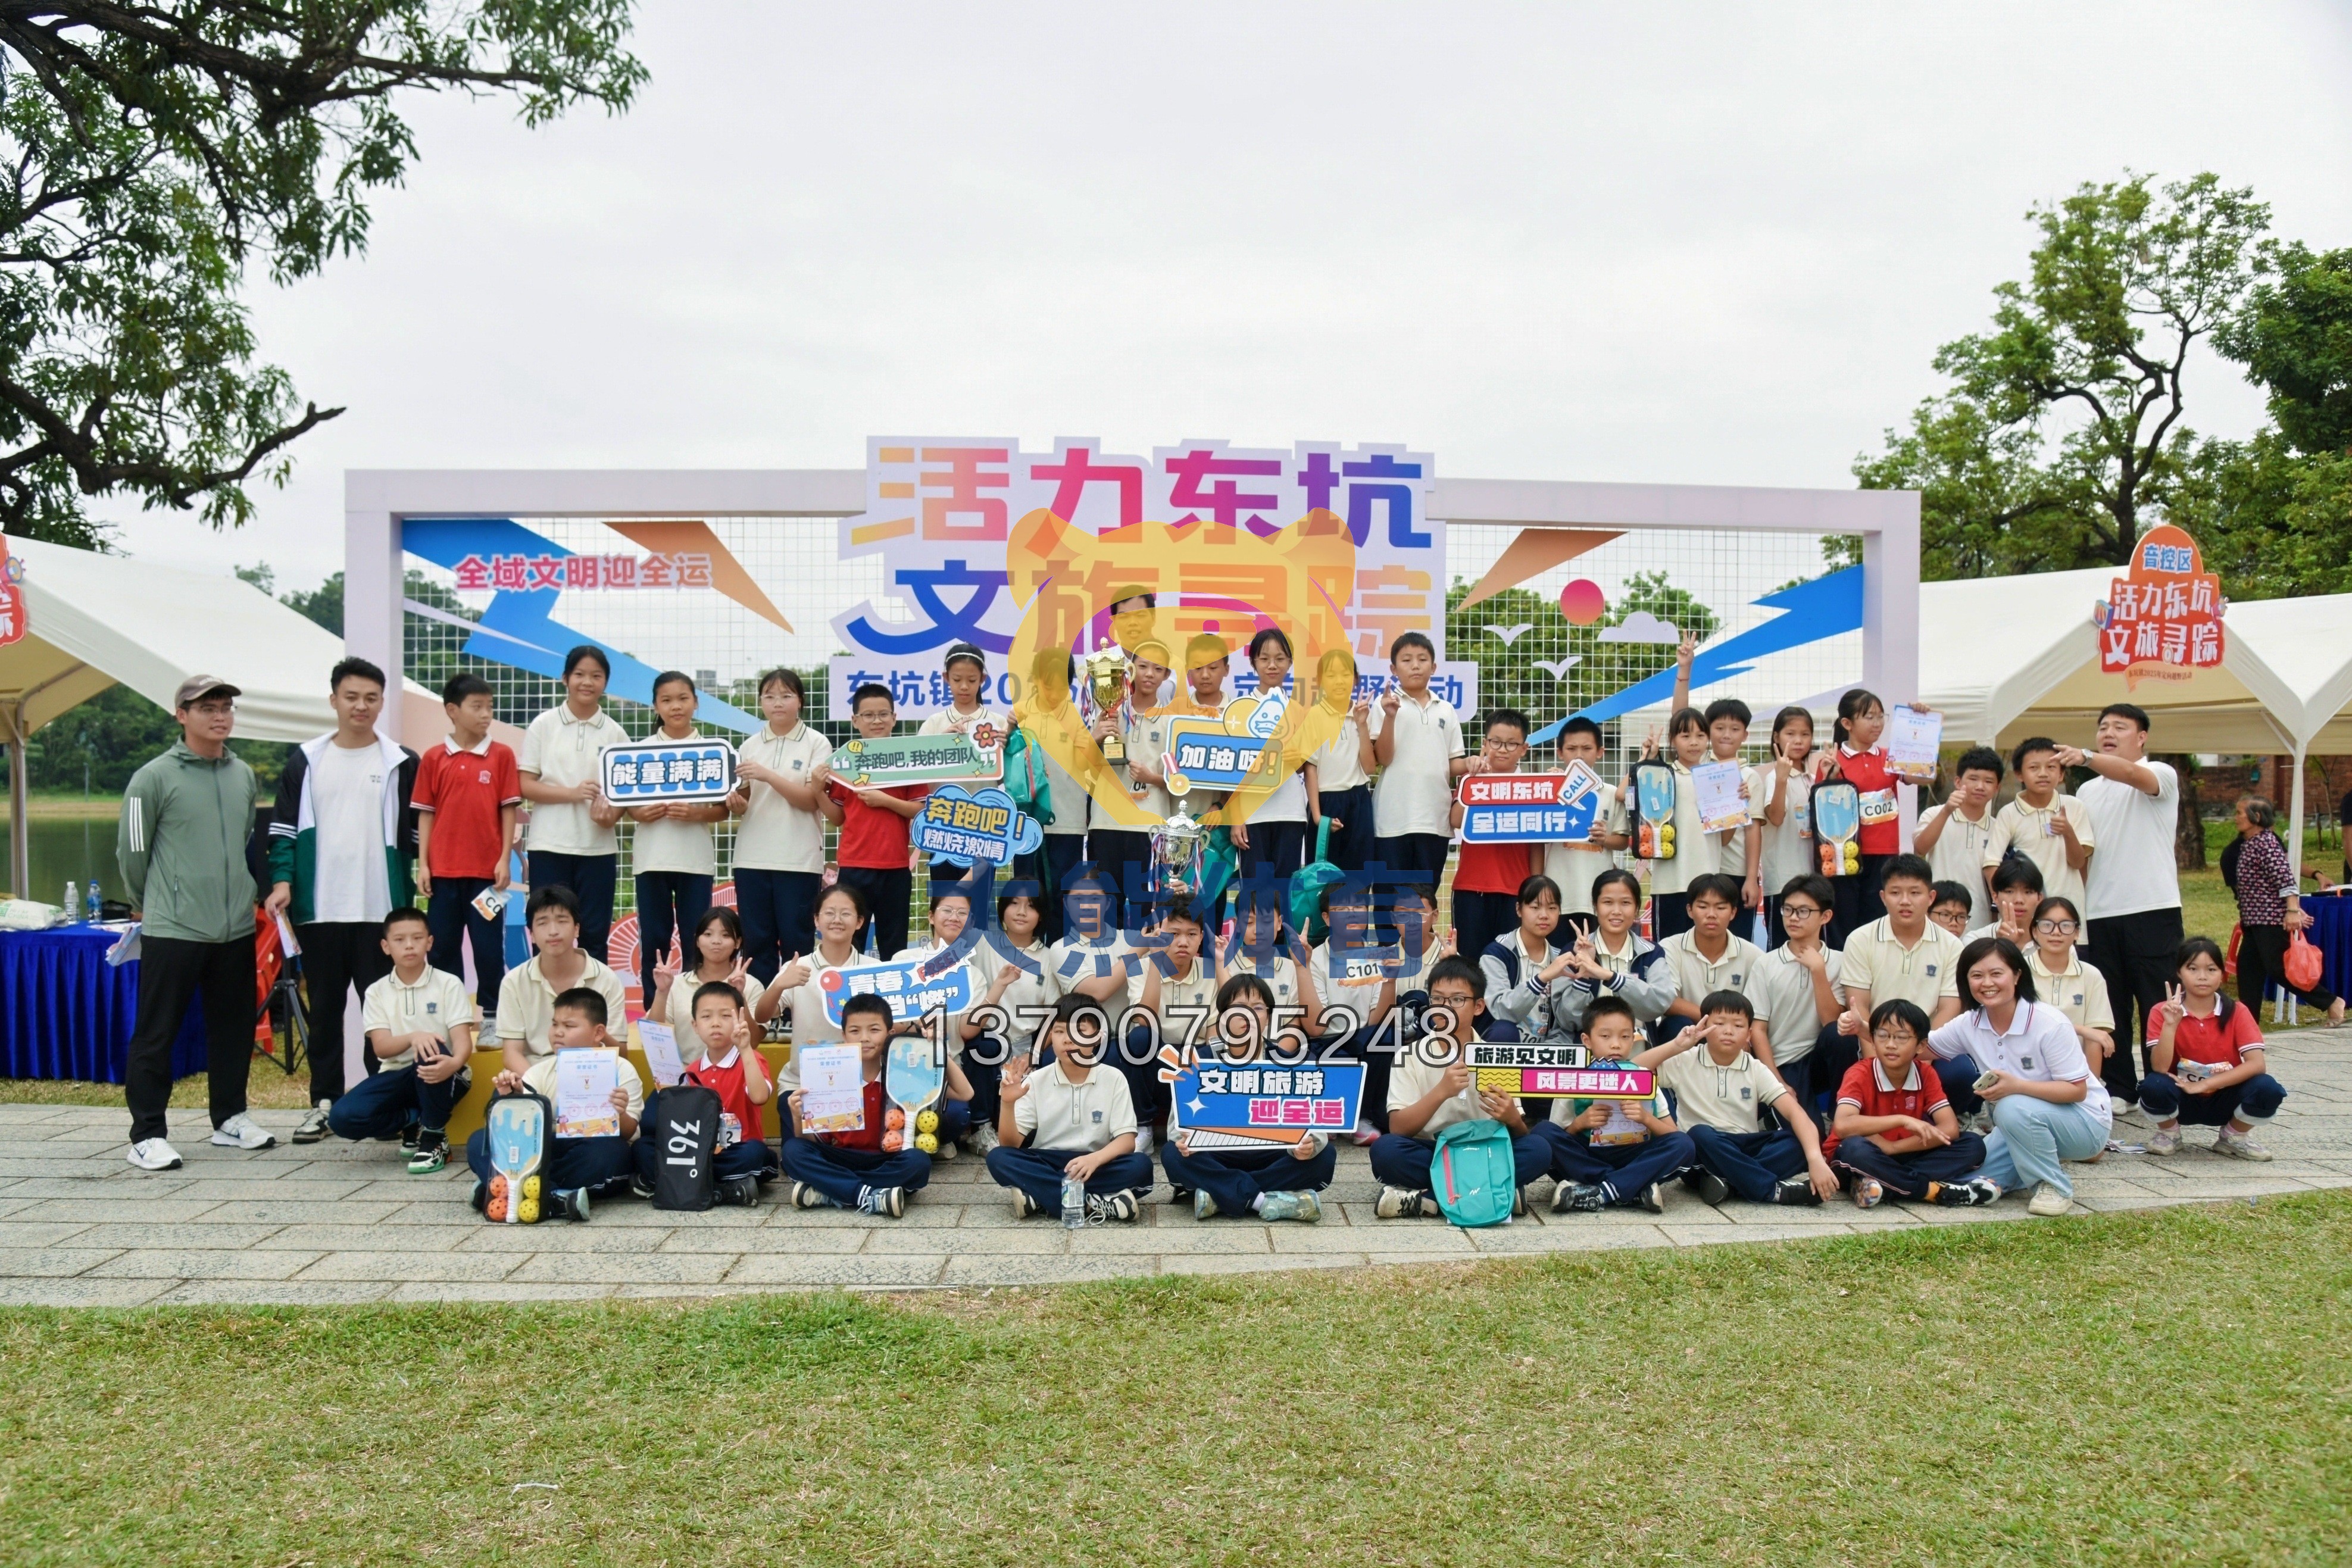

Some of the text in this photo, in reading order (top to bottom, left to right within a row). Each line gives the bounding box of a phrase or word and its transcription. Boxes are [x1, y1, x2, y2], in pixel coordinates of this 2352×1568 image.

[851, 448, 1431, 548] 活力东坑
[2144, 543, 2193, 573] 音控区
[457, 555, 712, 589] 全域文明迎全运
[2113, 579, 2213, 620] 活力东坑
[2106, 621, 2218, 666] 文旅寻踪
[613, 758, 722, 785] 能量满满
[1470, 781, 1553, 801] 文明东坑
[1563, 775, 1586, 799] CALL
[1472, 810, 1566, 833] 全运同行
[1864, 801, 1893, 816] C002
[923, 828, 1006, 861] 燃烧激情
[917, 949, 960, 982] FREE!
[1347, 963, 1378, 978] C101
[848, 970, 903, 996] 青春
[1475, 1045, 1576, 1067] 旅游见文明
[1199, 1068, 1325, 1095] 文明旅游
[1536, 1071, 1638, 1092] 风景更迷人
[1248, 1097, 1344, 1125] 迎全运
